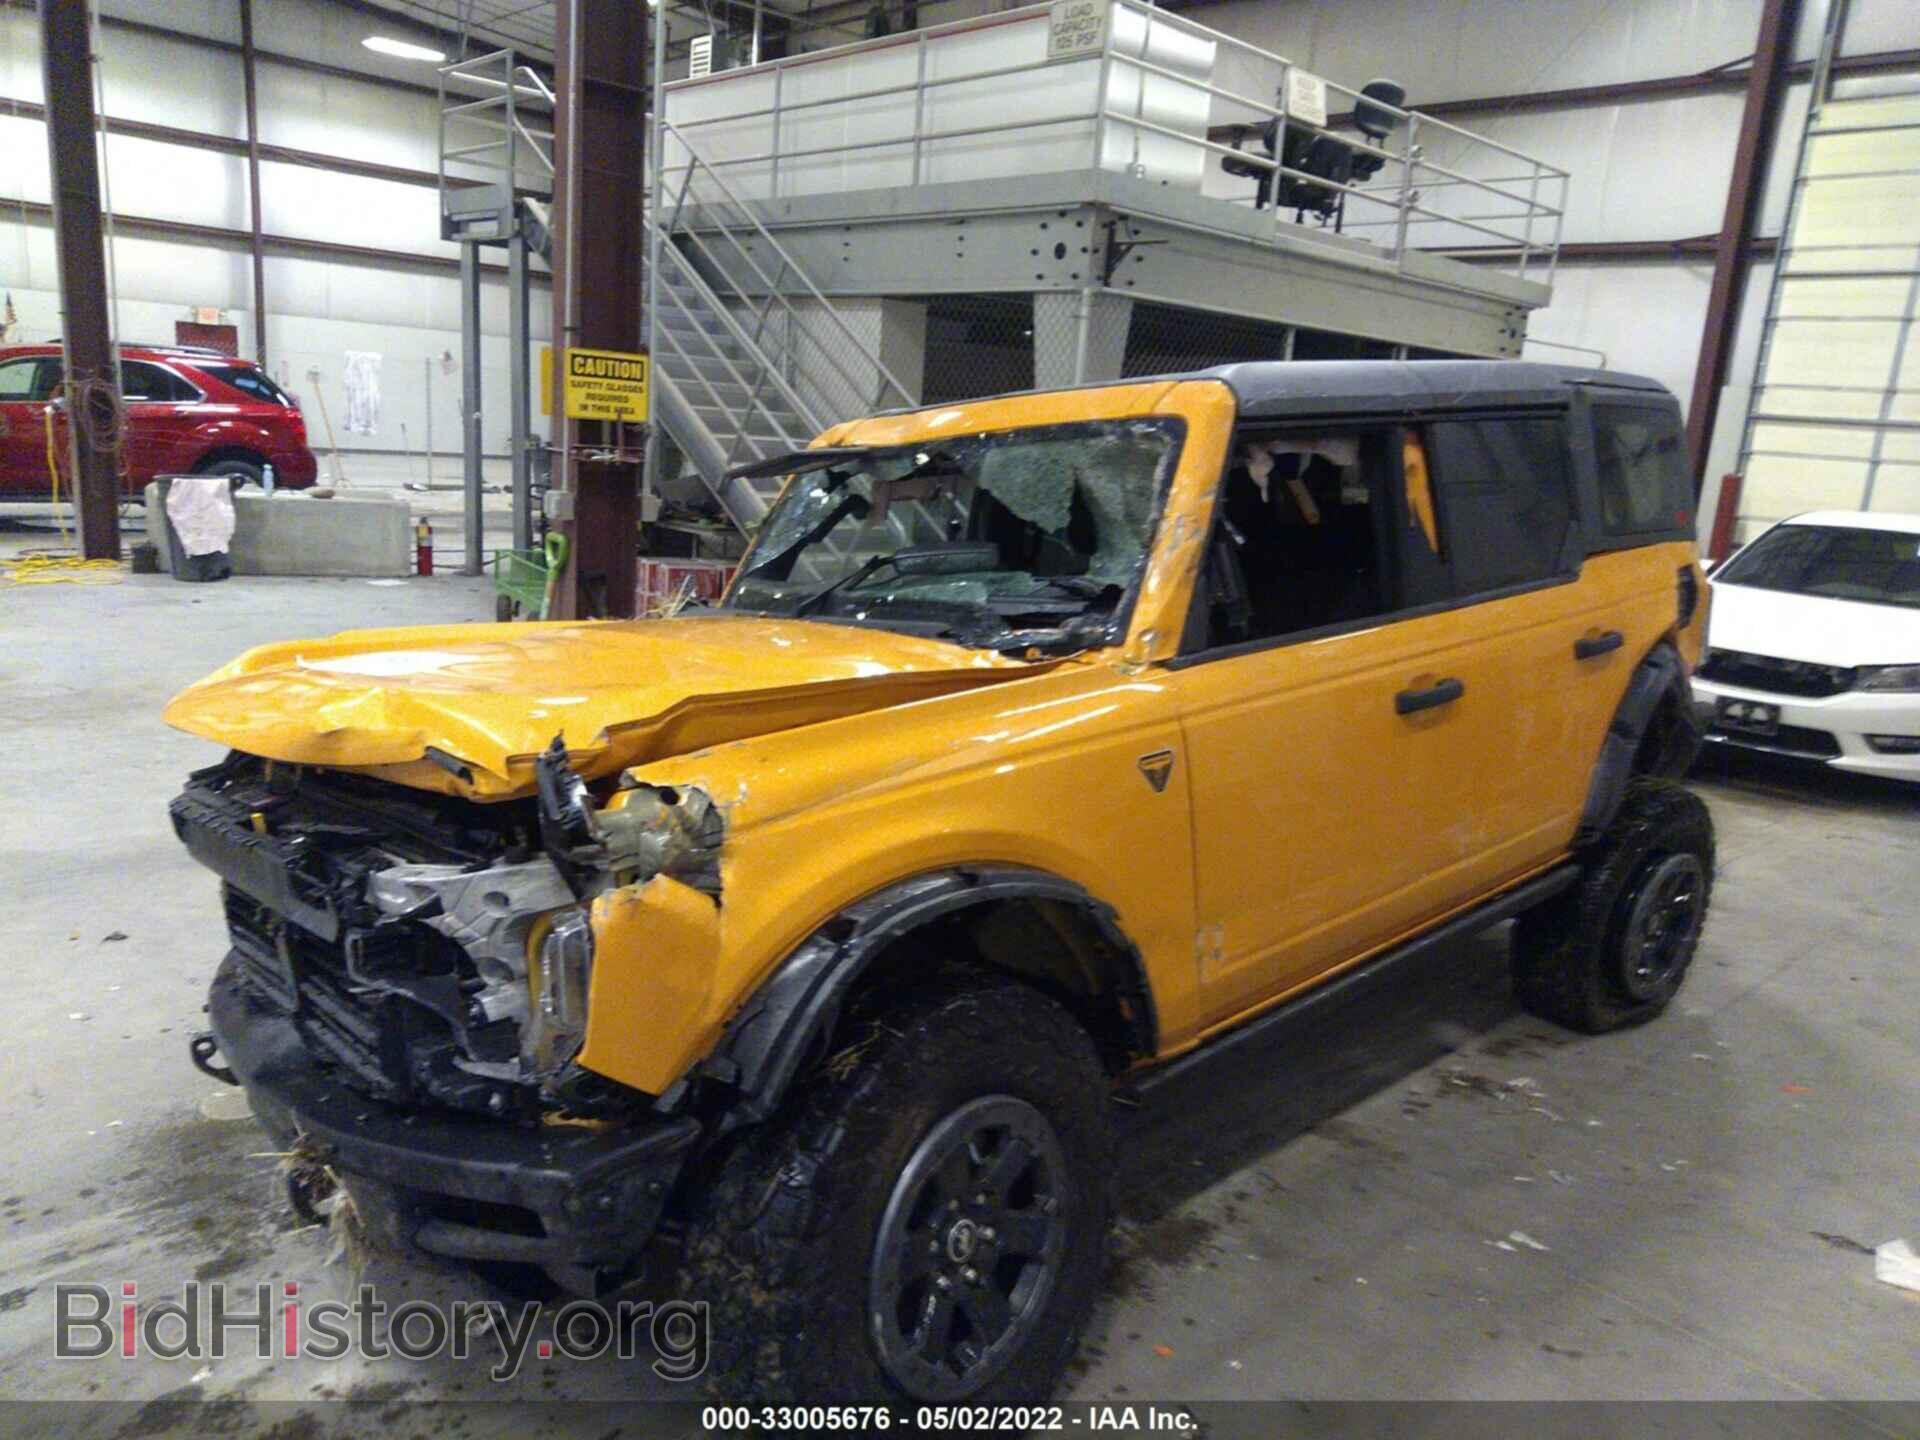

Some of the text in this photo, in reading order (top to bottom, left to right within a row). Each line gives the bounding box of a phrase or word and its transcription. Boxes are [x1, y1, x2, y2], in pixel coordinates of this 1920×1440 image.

[1063, 2, 1094, 20] LOAD
[1054, 17, 1102, 34] CAPACITY
[1056, 36, 1073, 49] 125
[573, 356, 642, 379] CAUTION
[571, 380, 643, 393] SAFETY GLASSES
